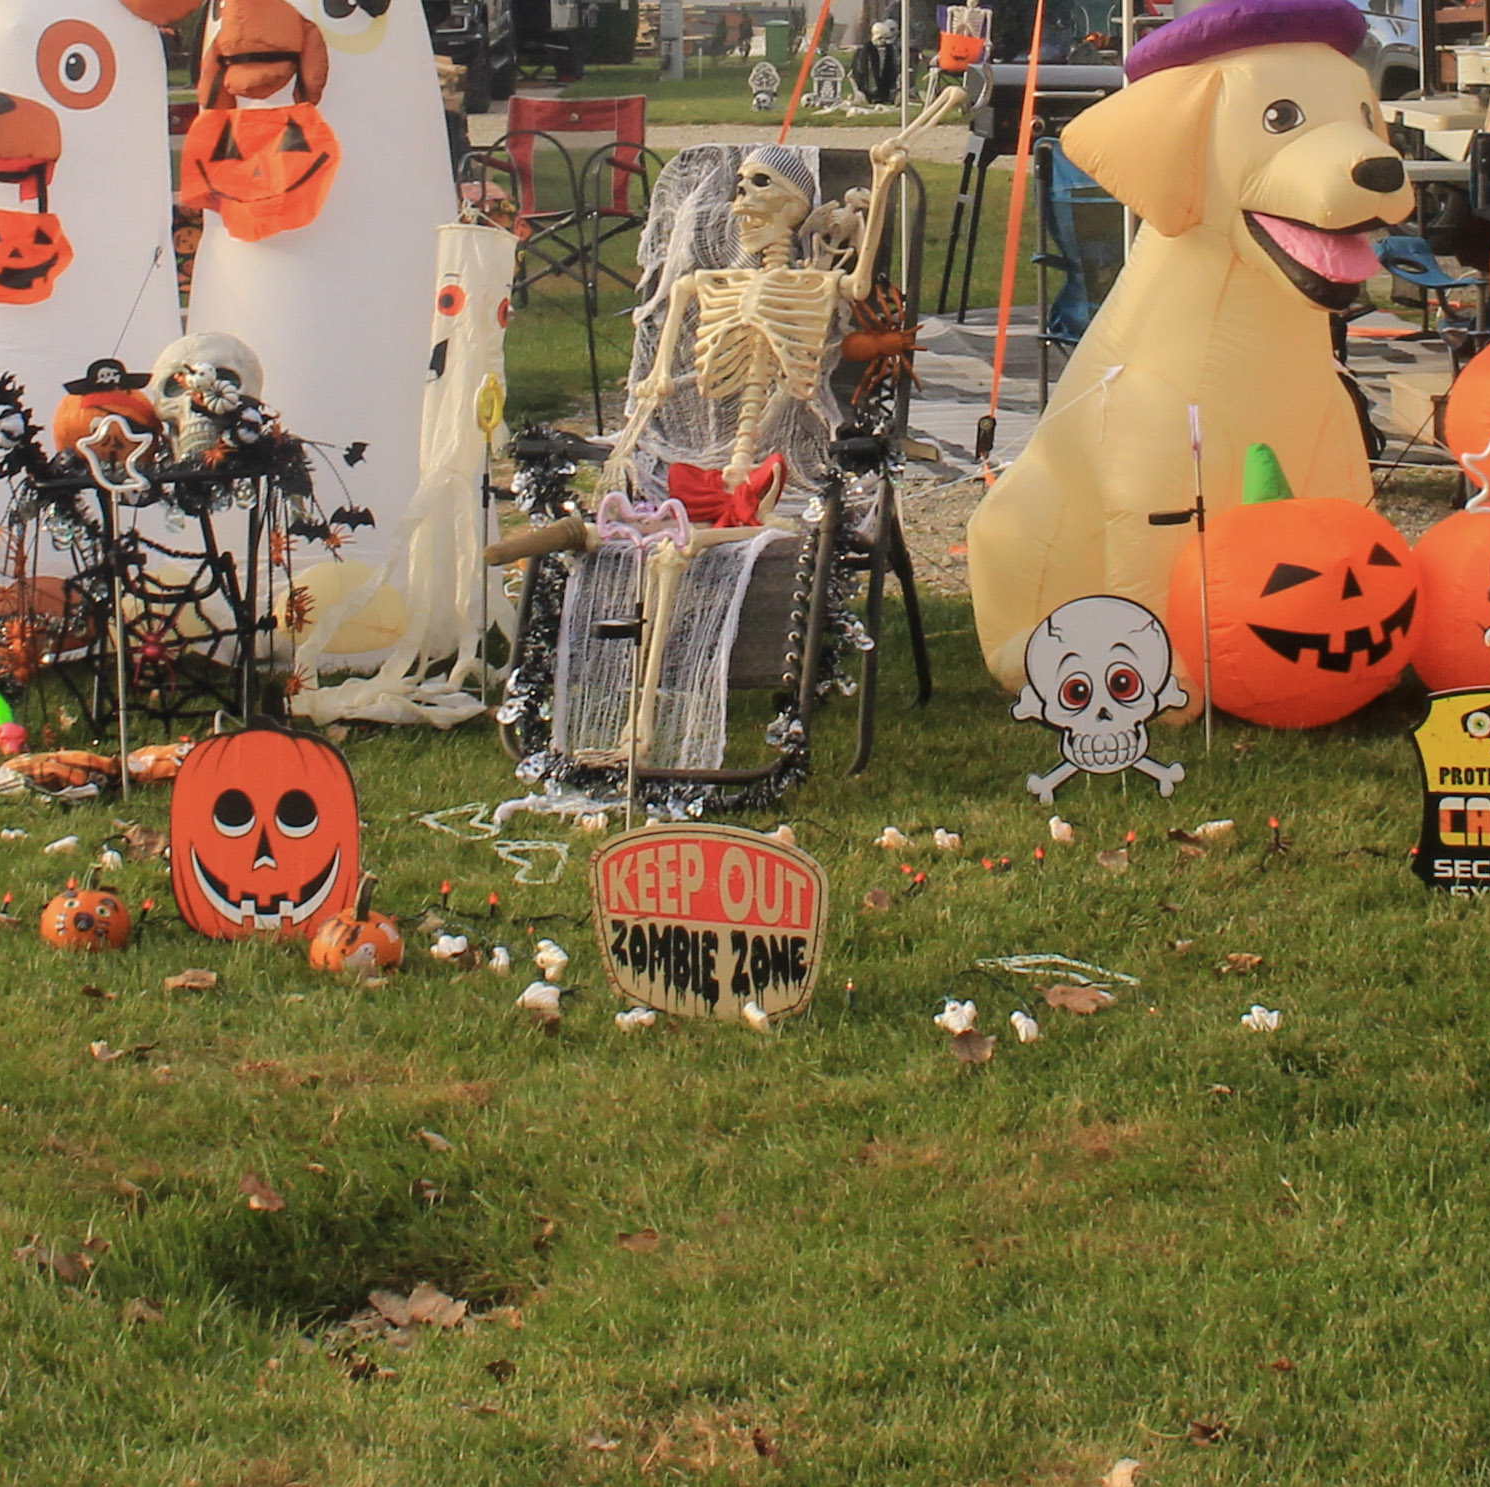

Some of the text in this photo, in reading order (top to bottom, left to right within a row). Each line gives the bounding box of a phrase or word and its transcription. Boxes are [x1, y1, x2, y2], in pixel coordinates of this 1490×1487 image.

[610, 843, 807, 926] KEEP OUT
[611, 919, 808, 1013] ZOMBIE ZONE
